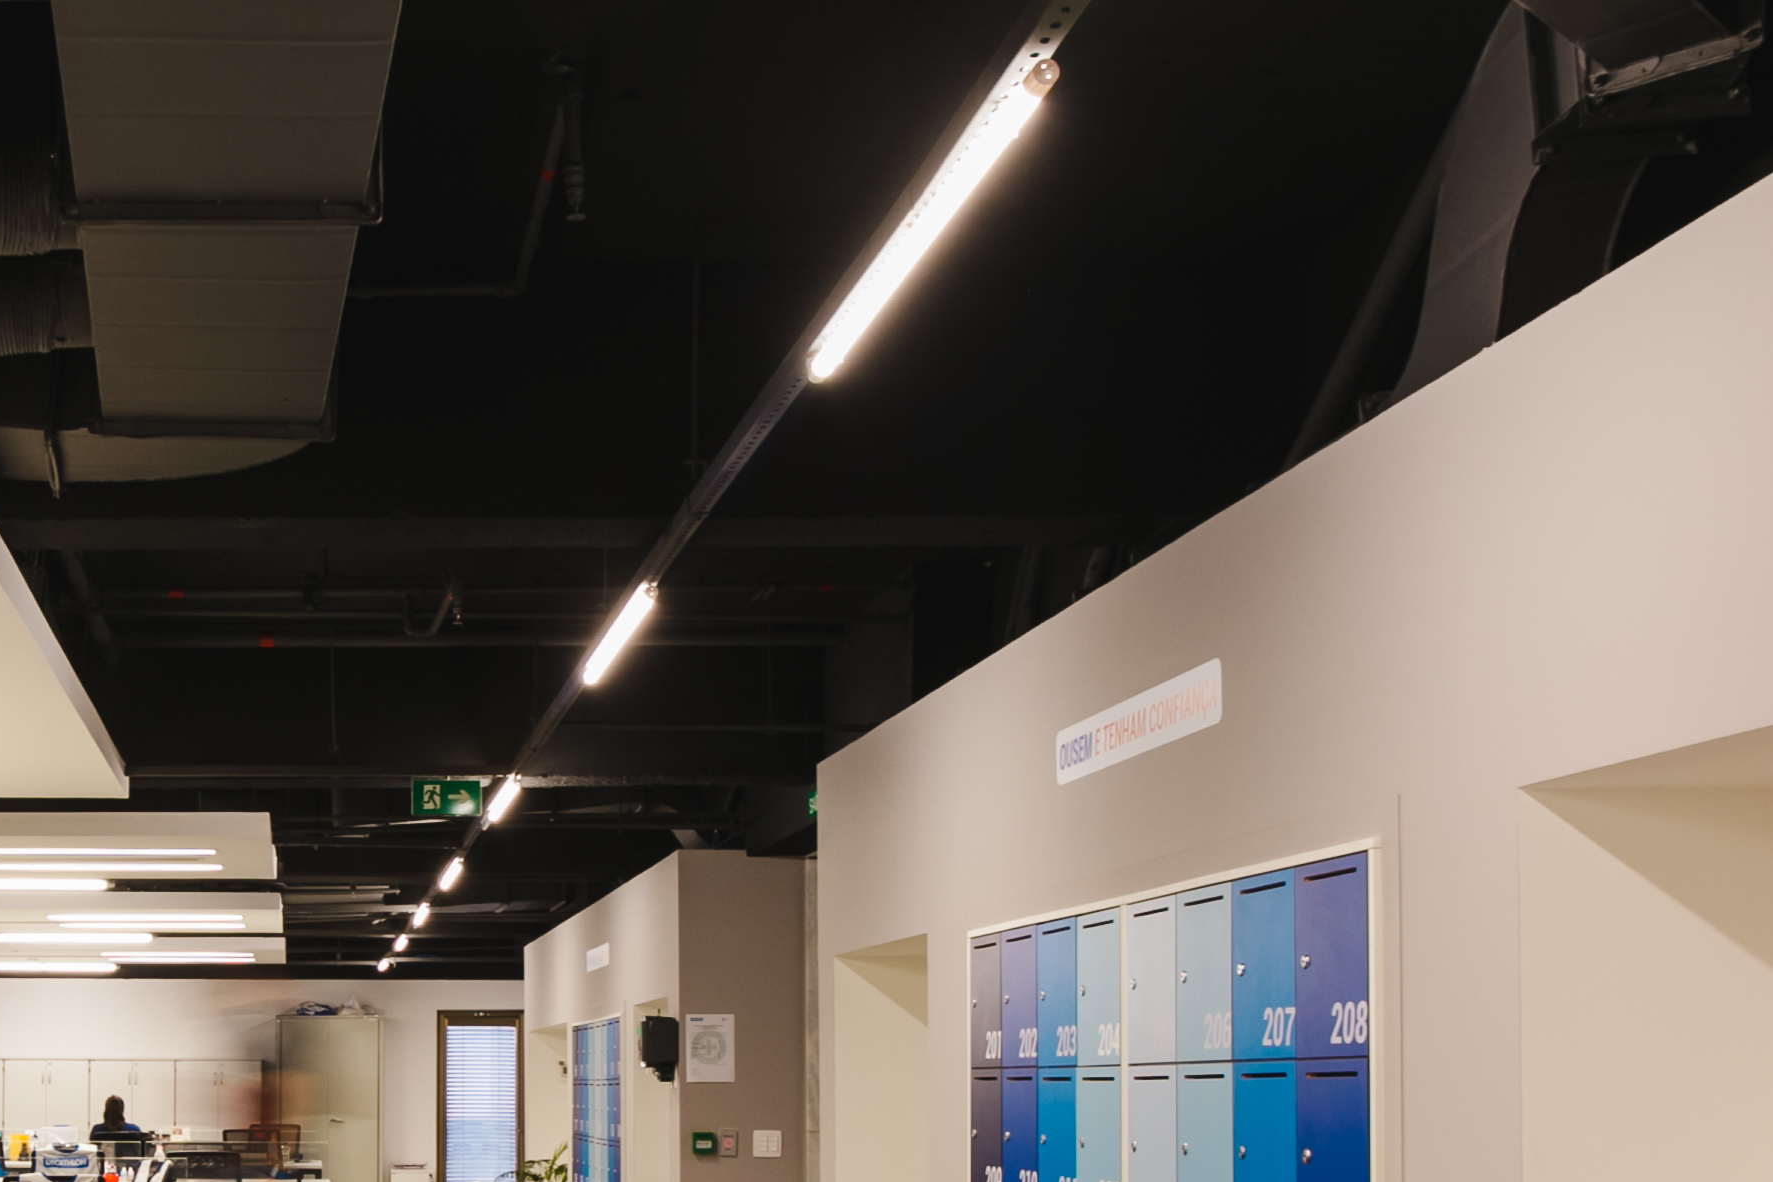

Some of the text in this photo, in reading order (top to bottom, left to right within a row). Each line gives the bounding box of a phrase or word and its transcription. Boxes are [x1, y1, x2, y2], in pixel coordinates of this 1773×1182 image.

[1059, 677, 1217, 770] OUSEM E TENHAM CONFIANÇA
[1098, 1023, 1121, 1056] 204
[1204, 1012, 1232, 1051] 206
[1262, 1007, 1296, 1047] 207
[1330, 1001, 1368, 1045] 208
[985, 1031, 1002, 1059] 201
[1019, 1028, 1038, 1058] 202
[1056, 1026, 1077, 1057] 203
[45, 1158, 87, 1166] DECATHLON
